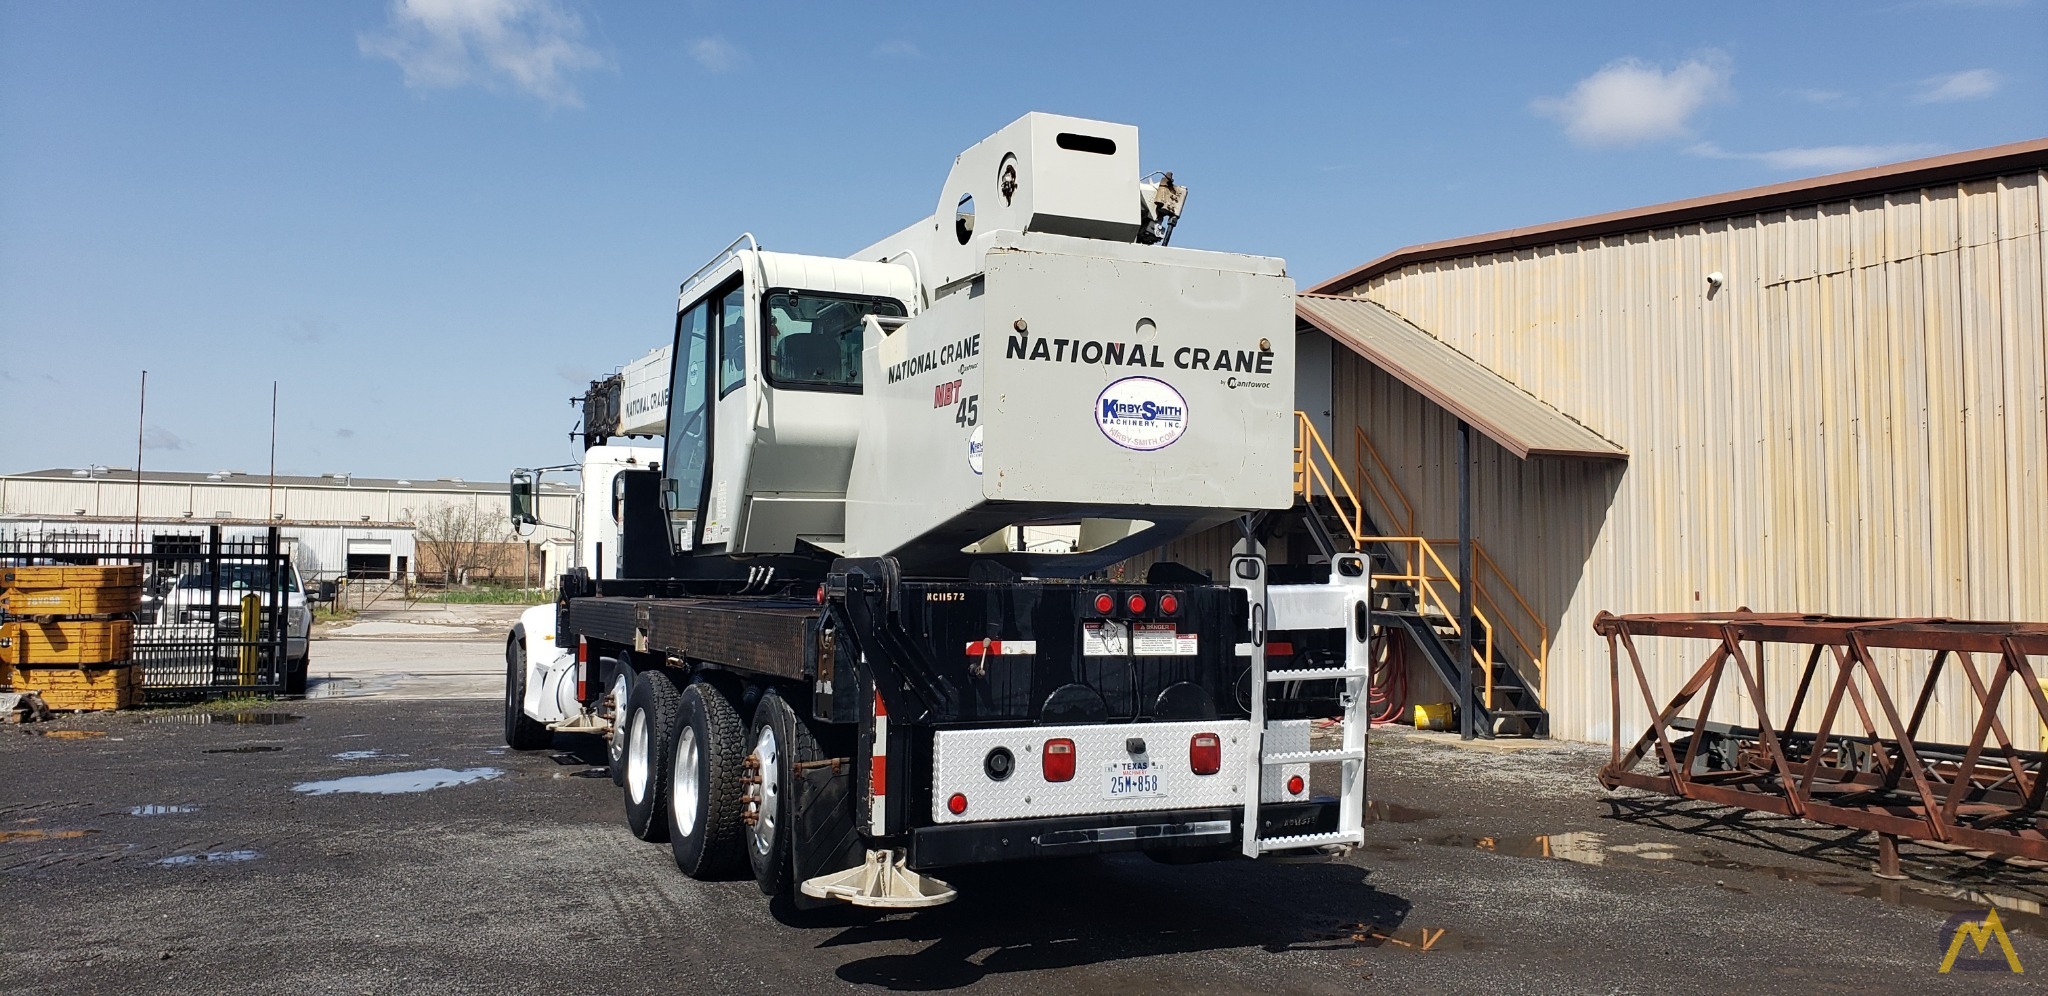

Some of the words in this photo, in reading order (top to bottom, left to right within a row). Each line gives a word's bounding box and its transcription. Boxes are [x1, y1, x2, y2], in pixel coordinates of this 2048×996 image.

[888, 350, 938, 384] NATIONAL
[940, 333, 980, 366] CRANE
[1006, 335, 1164, 368] NATIONAL
[1174, 347, 1274, 374] CRANE
[934, 379, 962, 409] NBT
[1227, 376, 1271, 389] Manitowoc
[626, 395, 650, 418] NATIONAL
[650, 388, 668, 410] CRANE
[956, 394, 979, 428] 45
[1102, 418, 1158, 428] MACHINERY,
[1109, 427, 1176, 446] KIRBY-SMITH.COM
